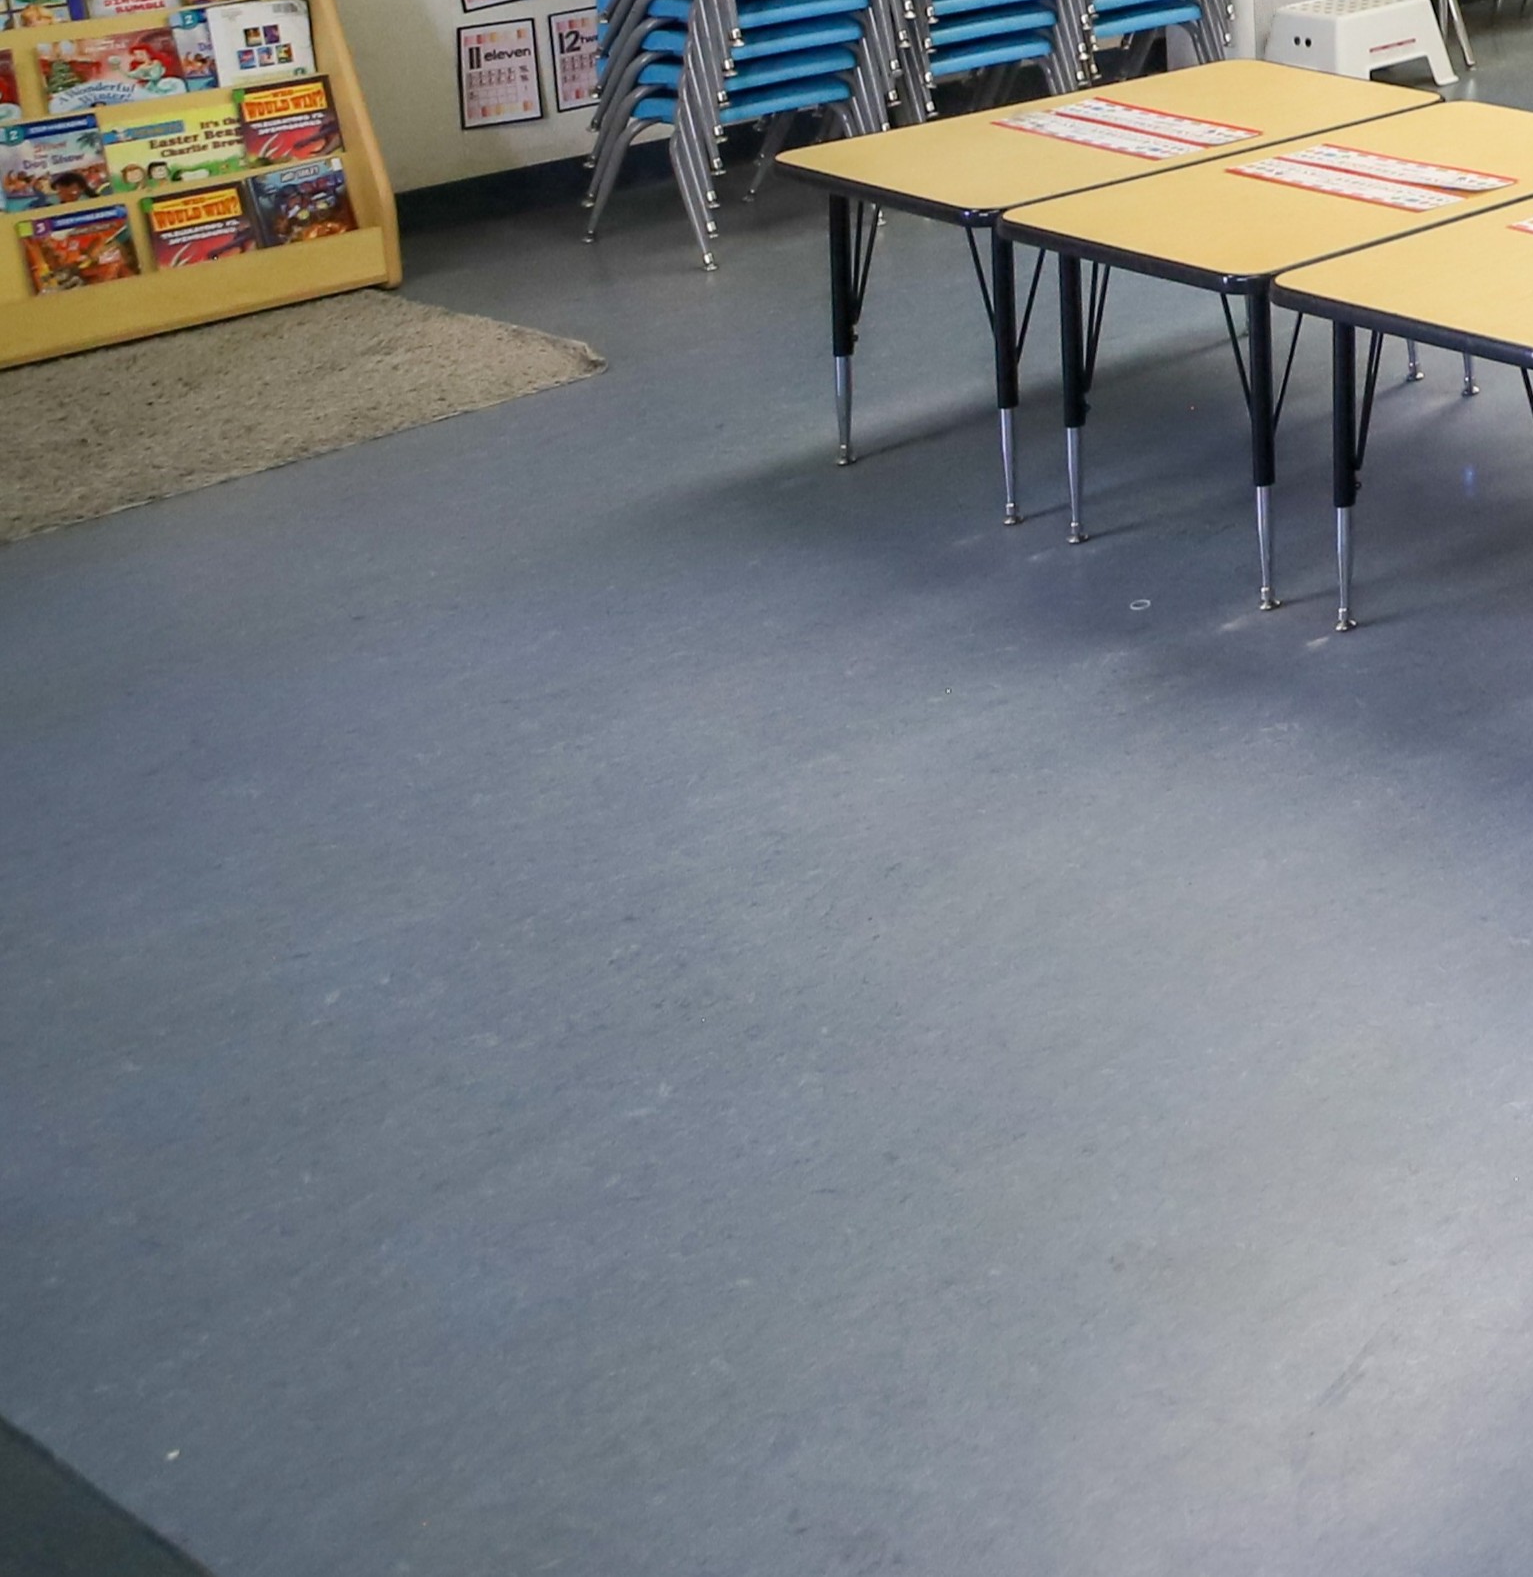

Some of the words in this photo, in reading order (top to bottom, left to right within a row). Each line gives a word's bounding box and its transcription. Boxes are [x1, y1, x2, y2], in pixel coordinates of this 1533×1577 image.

[184, 15, 194, 25] 2
[558, 30, 581, 54] 12
[468, 46, 482, 71] 11
[483, 46, 531, 62] eleven
[8, 130, 19, 141] 2
[148, 132, 199, 150] Easter
[160, 143, 210, 158] Charlie
[22, 159, 48, 170] Dog
[51, 152, 86, 166] Show
